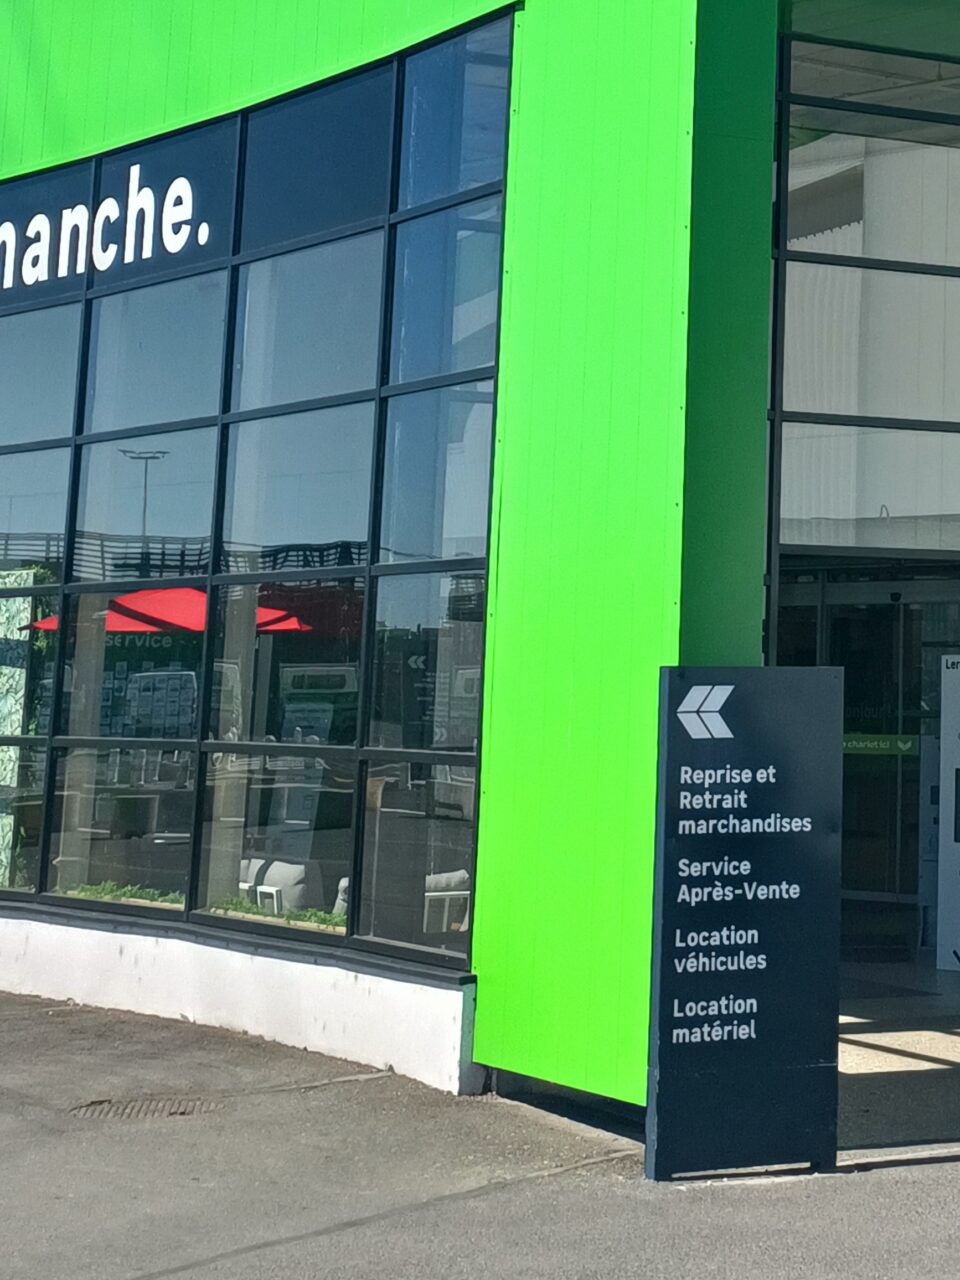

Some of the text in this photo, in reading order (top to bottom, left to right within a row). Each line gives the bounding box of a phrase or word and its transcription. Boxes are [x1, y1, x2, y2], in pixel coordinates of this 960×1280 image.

[680, 765, 776, 788] Reprise et
[679, 790, 748, 809] Retrait
[678, 813, 812, 835] marchandises
[678, 856, 751, 877] Service
[677, 880, 800, 906] Après-Vente
[675, 926, 758, 948] Location
[674, 950, 767, 973] véhicules
[673, 995, 757, 1018] Location
[672, 1020, 756, 1044] matériel
